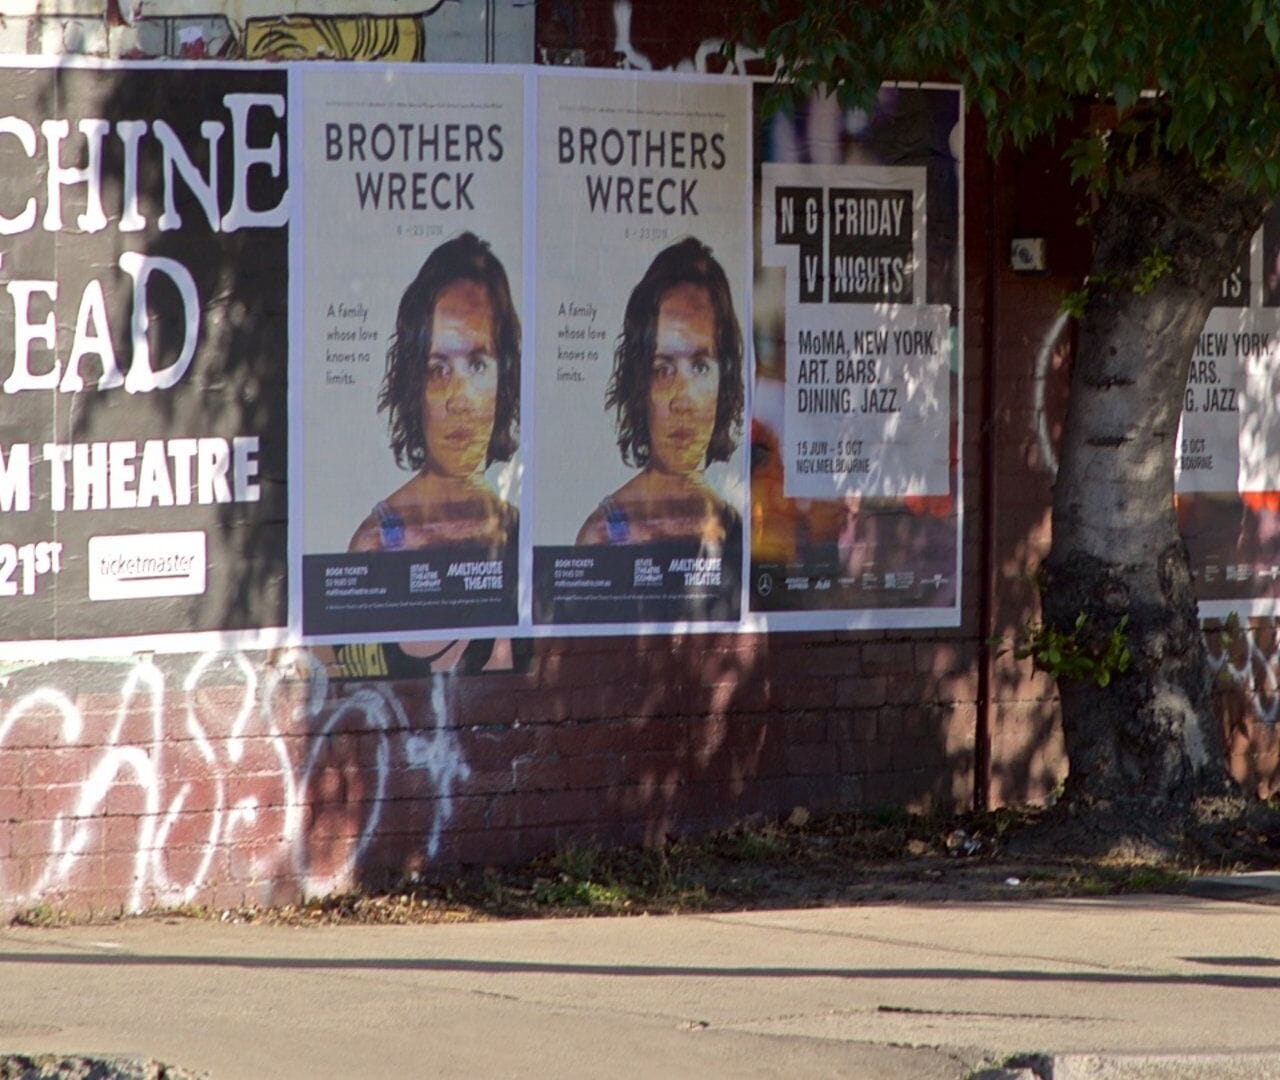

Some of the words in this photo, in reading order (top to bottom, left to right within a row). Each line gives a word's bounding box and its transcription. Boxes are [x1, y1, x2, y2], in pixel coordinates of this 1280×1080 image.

[325, 122, 504, 162] BROTHERS
[558, 127, 727, 169] BROTHERS
[356, 172, 475, 211] WRECK
[586, 174, 699, 216] WRECK
[834, 198, 904, 236] FRIDAY
[834, 256, 904, 295] NIGHTS
[326, 304, 336, 318] A
[338, 302, 368, 323] family
[558, 302, 567, 316] A
[568, 301, 598, 322] family
[327, 326, 357, 341] whose
[359, 326, 379, 341] love
[558, 324, 586, 339] whose
[588, 324, 607, 339] love
[326, 348, 356, 363] knows
[358, 351, 371, 363] no
[557, 345, 586, 360] knows
[588, 349, 600, 360] no
[798, 330, 851, 359] MoMA,
[854, 331, 888, 357] NEW
[893, 331, 939, 357] YORK.
[1195, 332, 1228, 358] NEW
[1231, 333, 1274, 358] YORK.
[797, 359, 831, 385] ART.
[834, 360, 882, 385] BARS.
[1189, 360, 1222, 385] ARS.
[797, 388, 857, 414] DINING.
[860, 389, 902, 414] JAZZ.
[1201, 388, 1240, 413] JAZZ.
[796, 440, 808, 457] 15
[809, 440, 828, 457] JUN
[837, 439, 844, 456] 5
[845, 439, 865, 456] OCT
[1189, 438, 1206, 453] OCT
[43, 436, 261, 512] THEATRE
[101, 553, 196, 577] ticketmaster
[446, 560, 504, 577] MALTHOUSE
[463, 575, 504, 592] THEATRE
[684, 572, 722, 587] THEATRE
